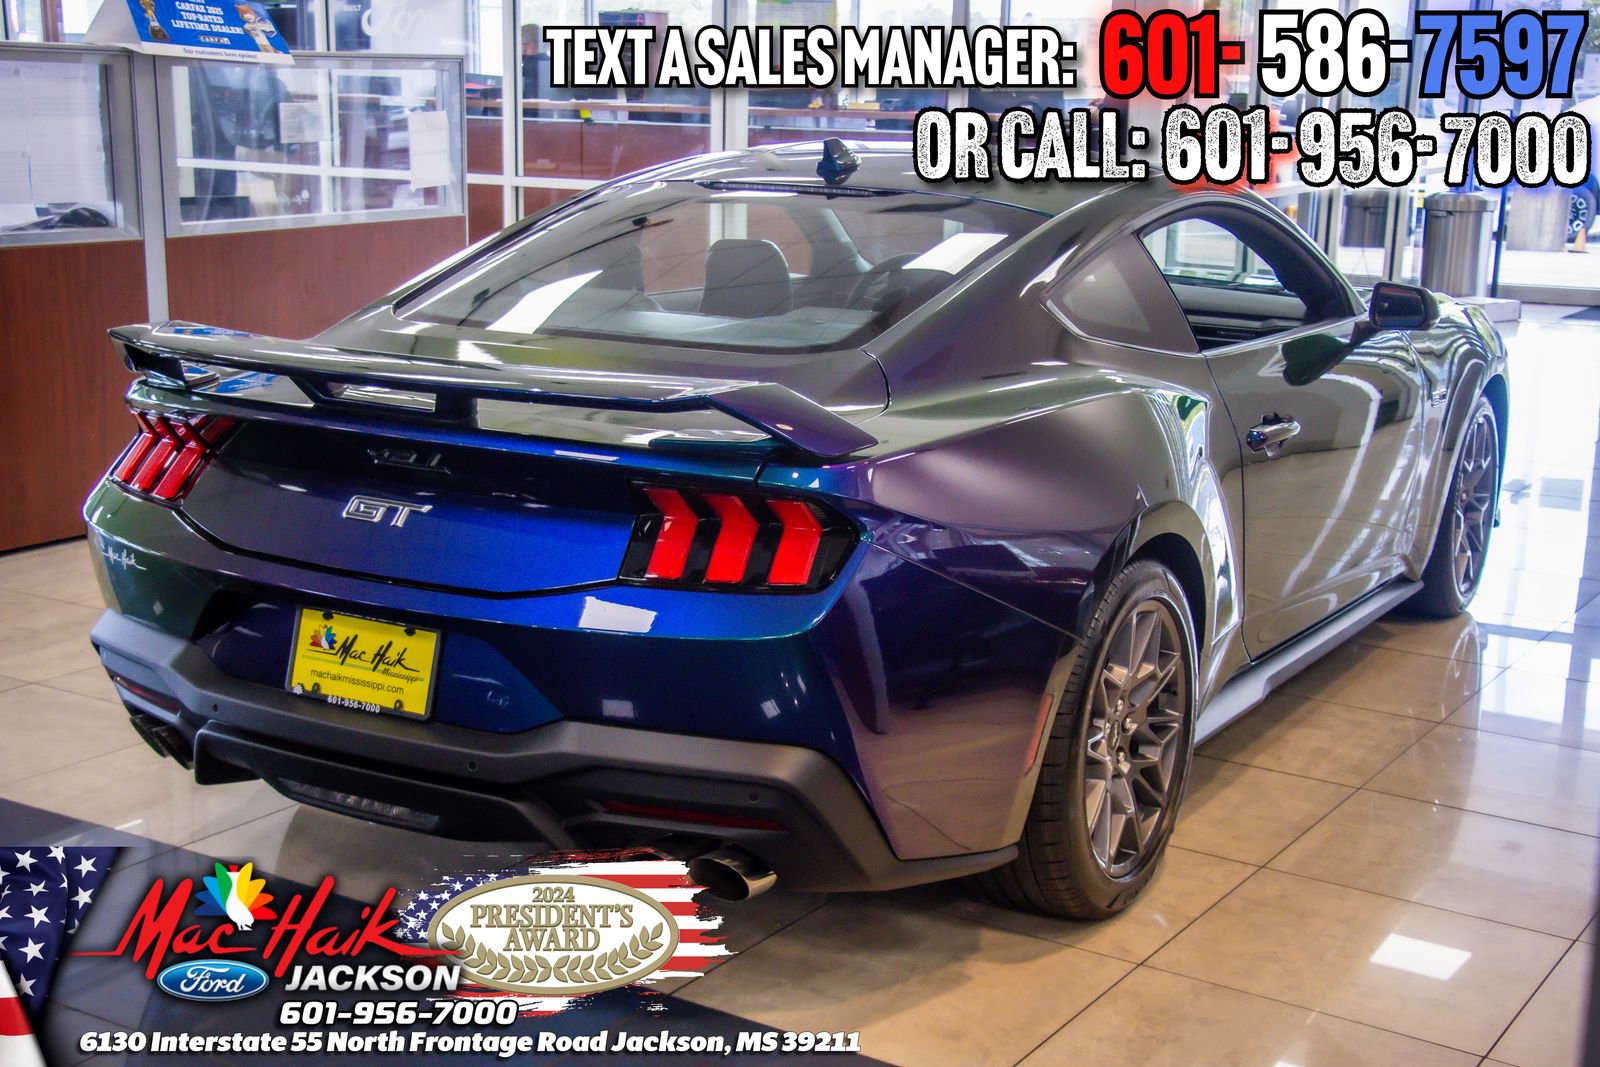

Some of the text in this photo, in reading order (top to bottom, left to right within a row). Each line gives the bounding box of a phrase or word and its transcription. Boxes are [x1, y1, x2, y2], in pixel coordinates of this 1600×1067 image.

[175, 2, 224, 15] CARFAX 2025
[180, 11, 224, 24] TOP-RATED
[171, 19, 245, 35] LIFETIME DEALER!
[343, 495, 433, 527] GT
[322, 634, 420, 672] Mac Haik
[310, 668, 405, 694] machaikmississippi.com
[381, 667, 419, 684] Mississippi
[327, 695, 381, 713] 601-956-7000
